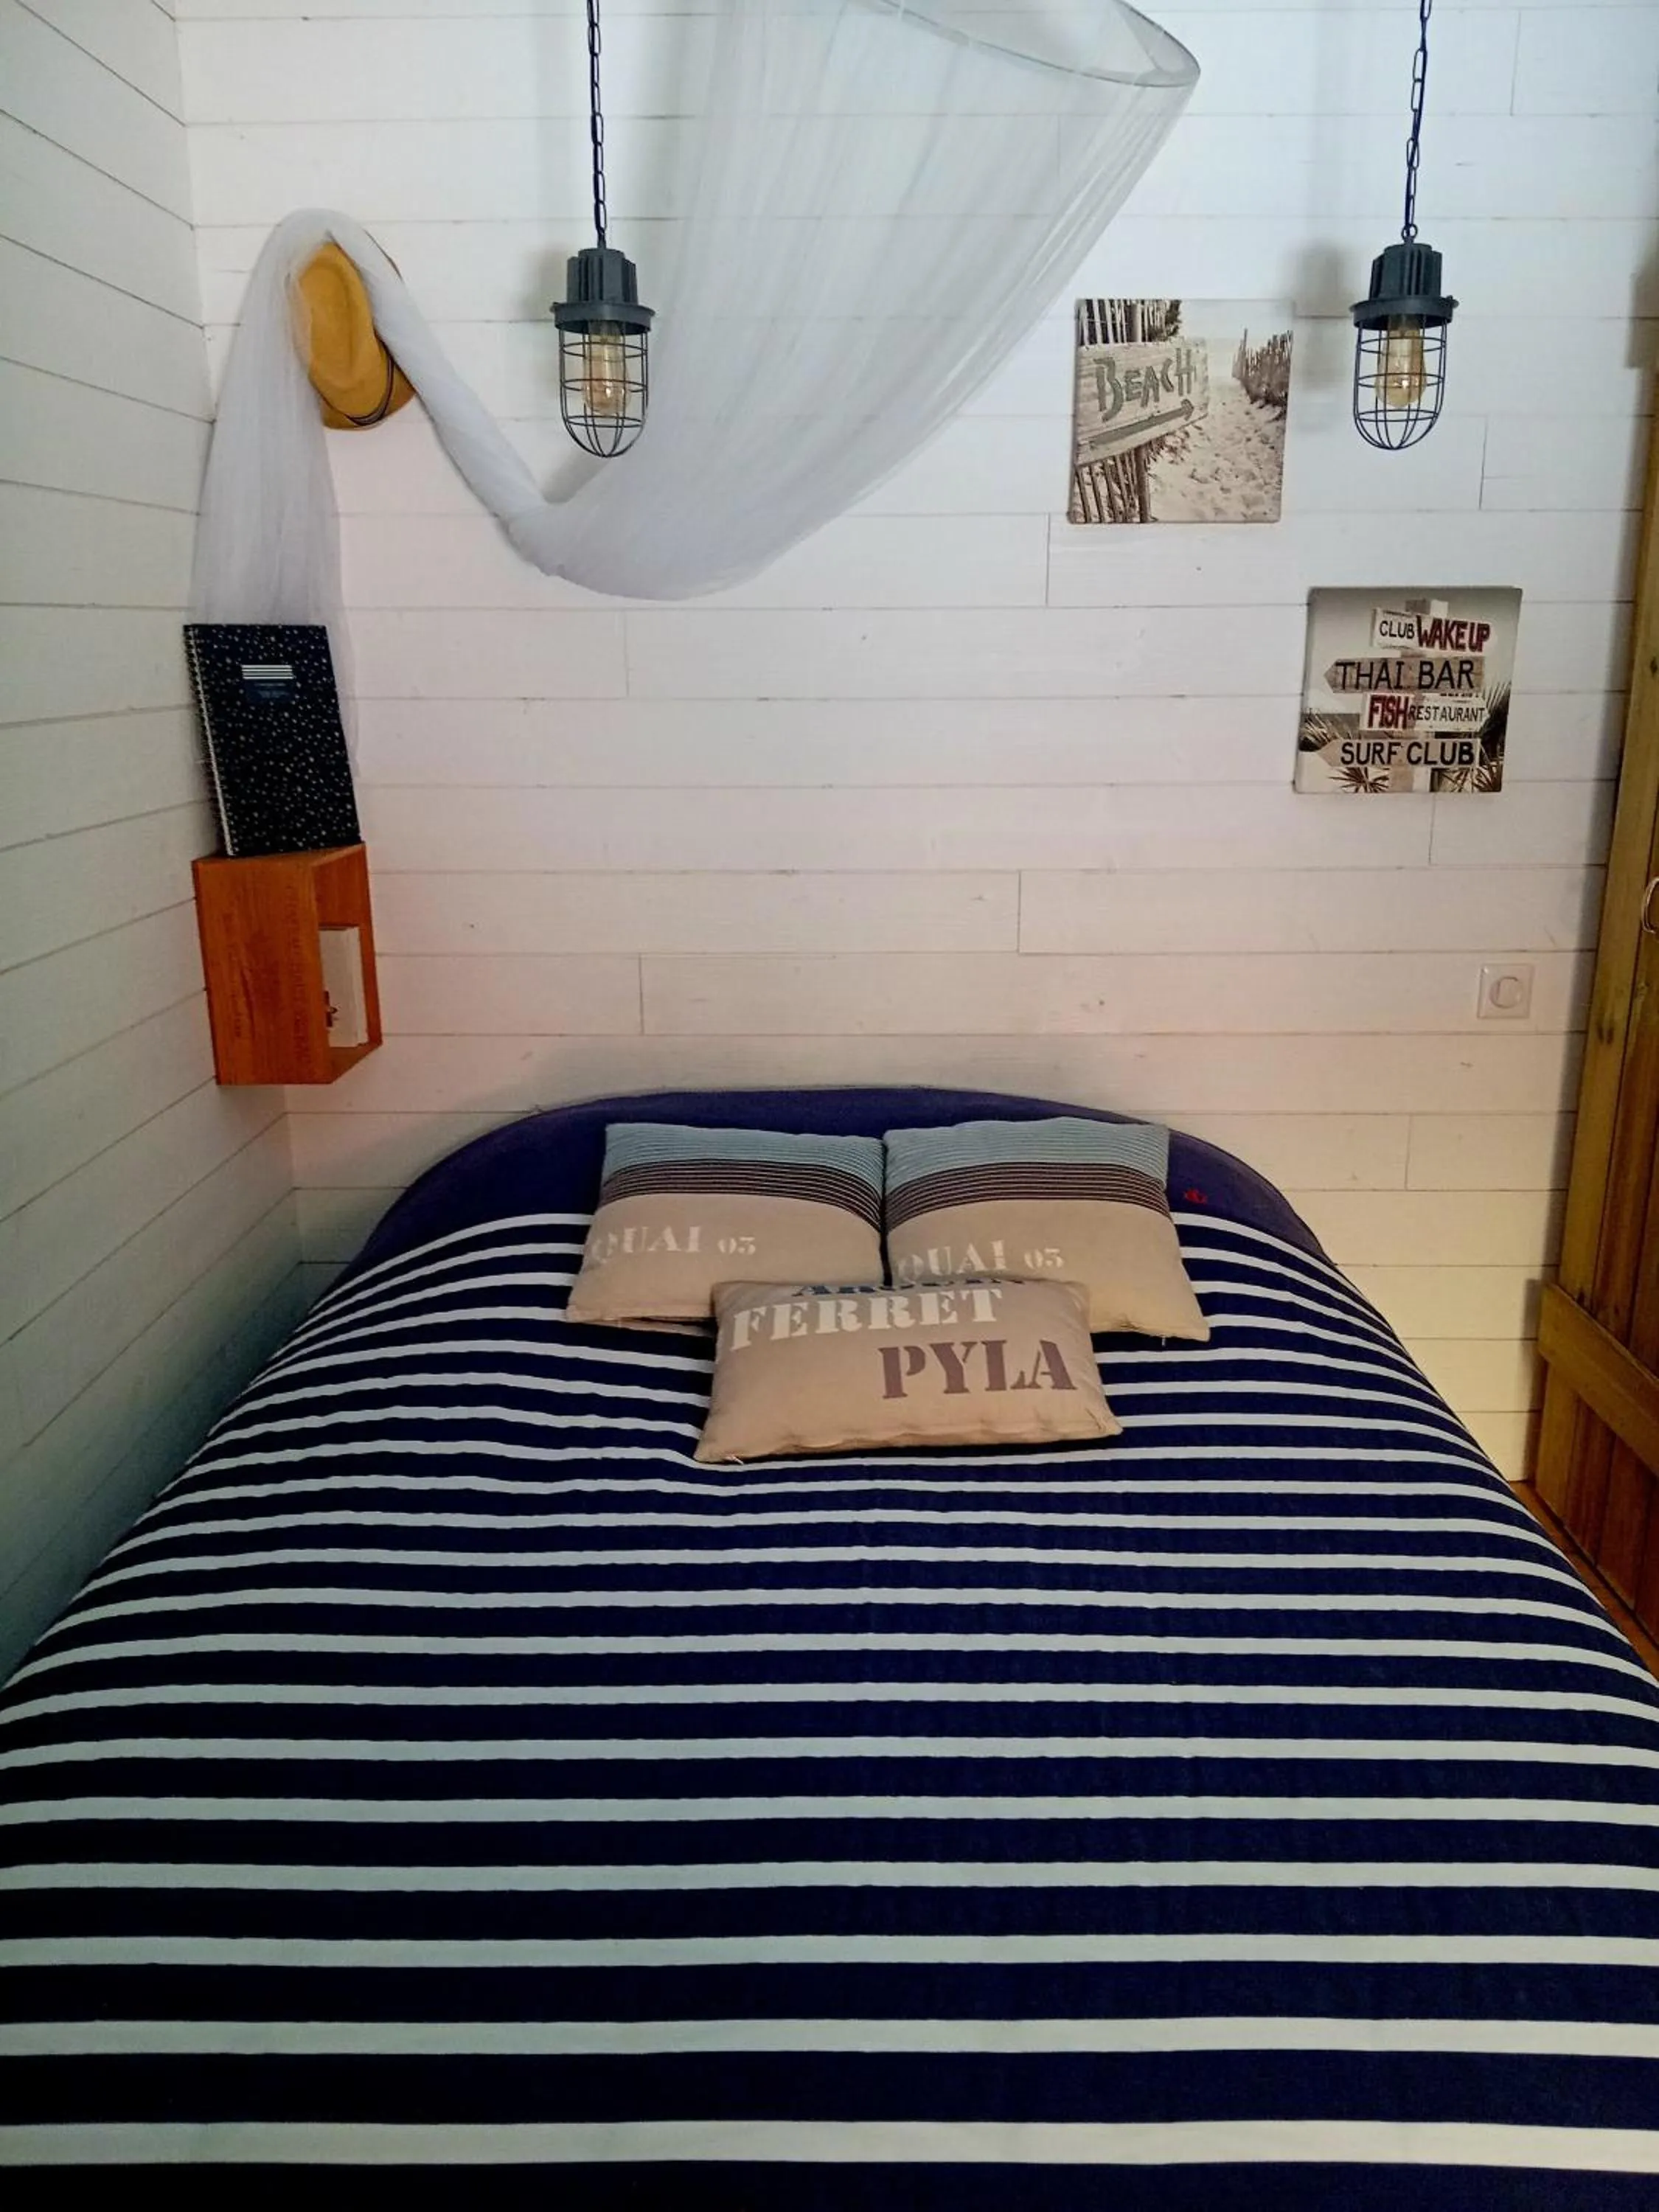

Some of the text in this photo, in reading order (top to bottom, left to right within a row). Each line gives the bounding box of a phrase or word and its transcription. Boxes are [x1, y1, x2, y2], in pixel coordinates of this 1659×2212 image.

[1093, 347, 1197, 422] BEACH
[1379, 615, 1492, 653] CLUB WAKE UP
[1334, 660, 1475, 690] THAI BAR
[1368, 695, 1486, 729] FISH RESTAURANT
[1340, 741, 1475, 766] SURF CLUB
[730, 1287, 1004, 1352] FERRET
[877, 1339, 1078, 1399] PYLA
